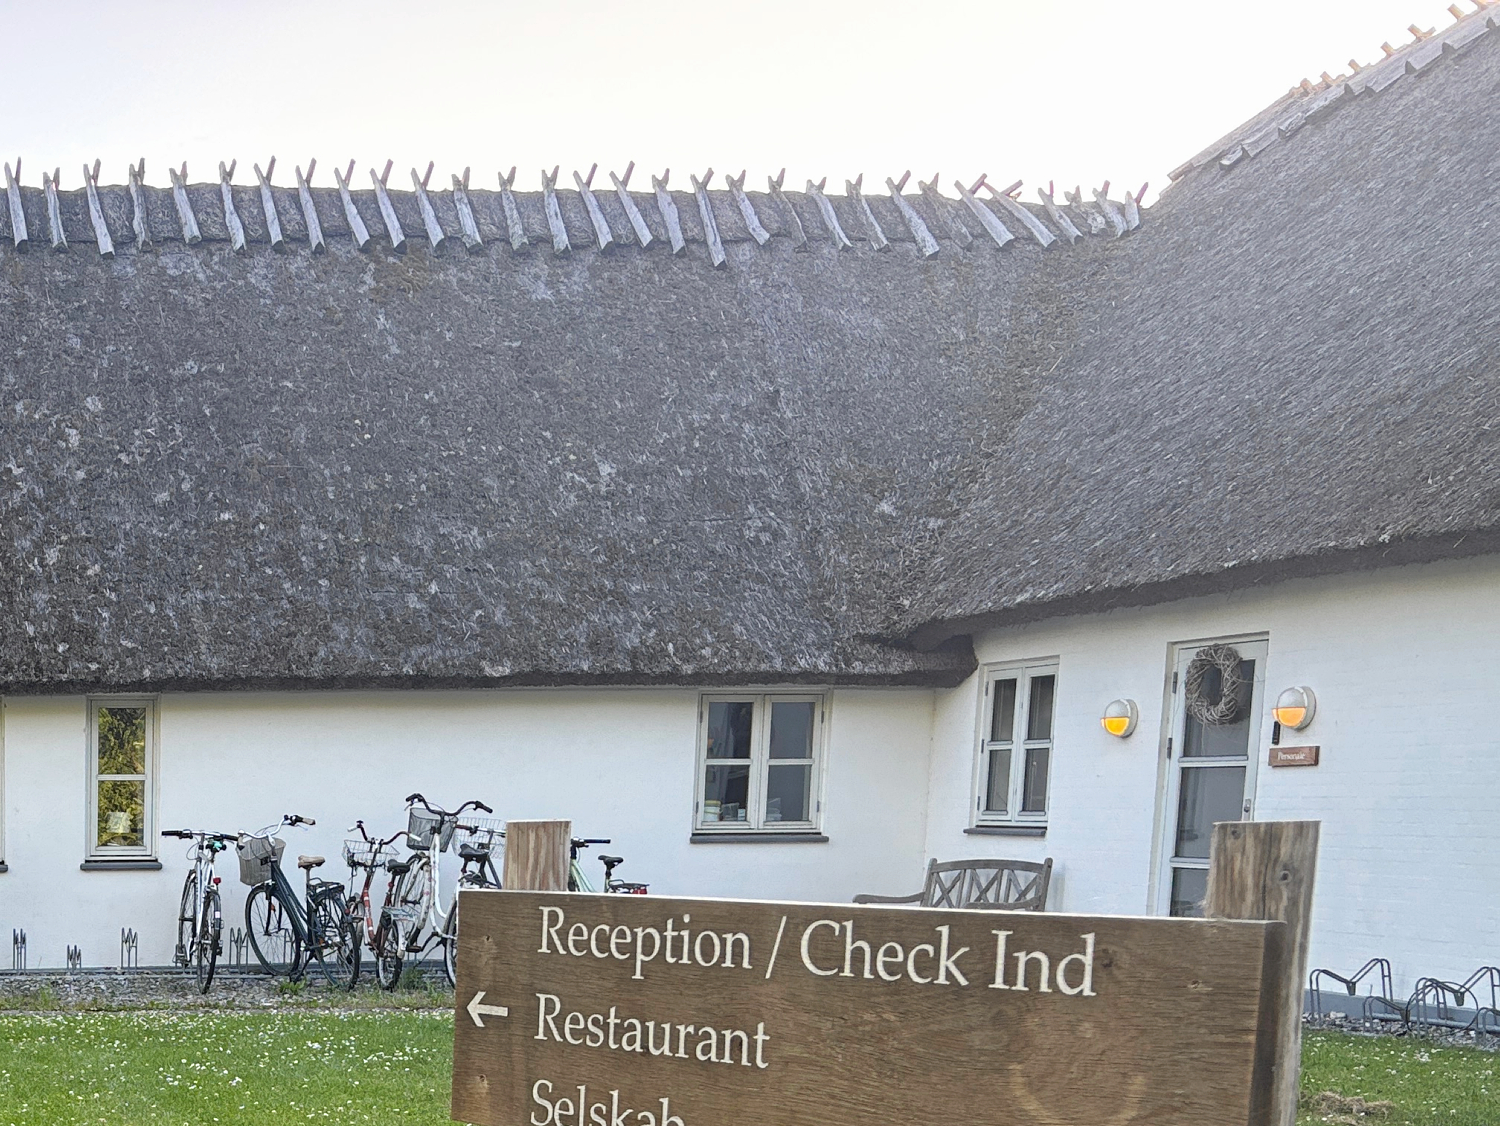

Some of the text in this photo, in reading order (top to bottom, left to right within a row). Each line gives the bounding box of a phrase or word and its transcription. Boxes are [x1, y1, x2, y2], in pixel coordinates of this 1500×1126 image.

[537, 905, 753, 980] Reception
[800, 918, 970, 987] Check
[988, 929, 1097, 997] Ind
[533, 992, 771, 1069] Restaurant
